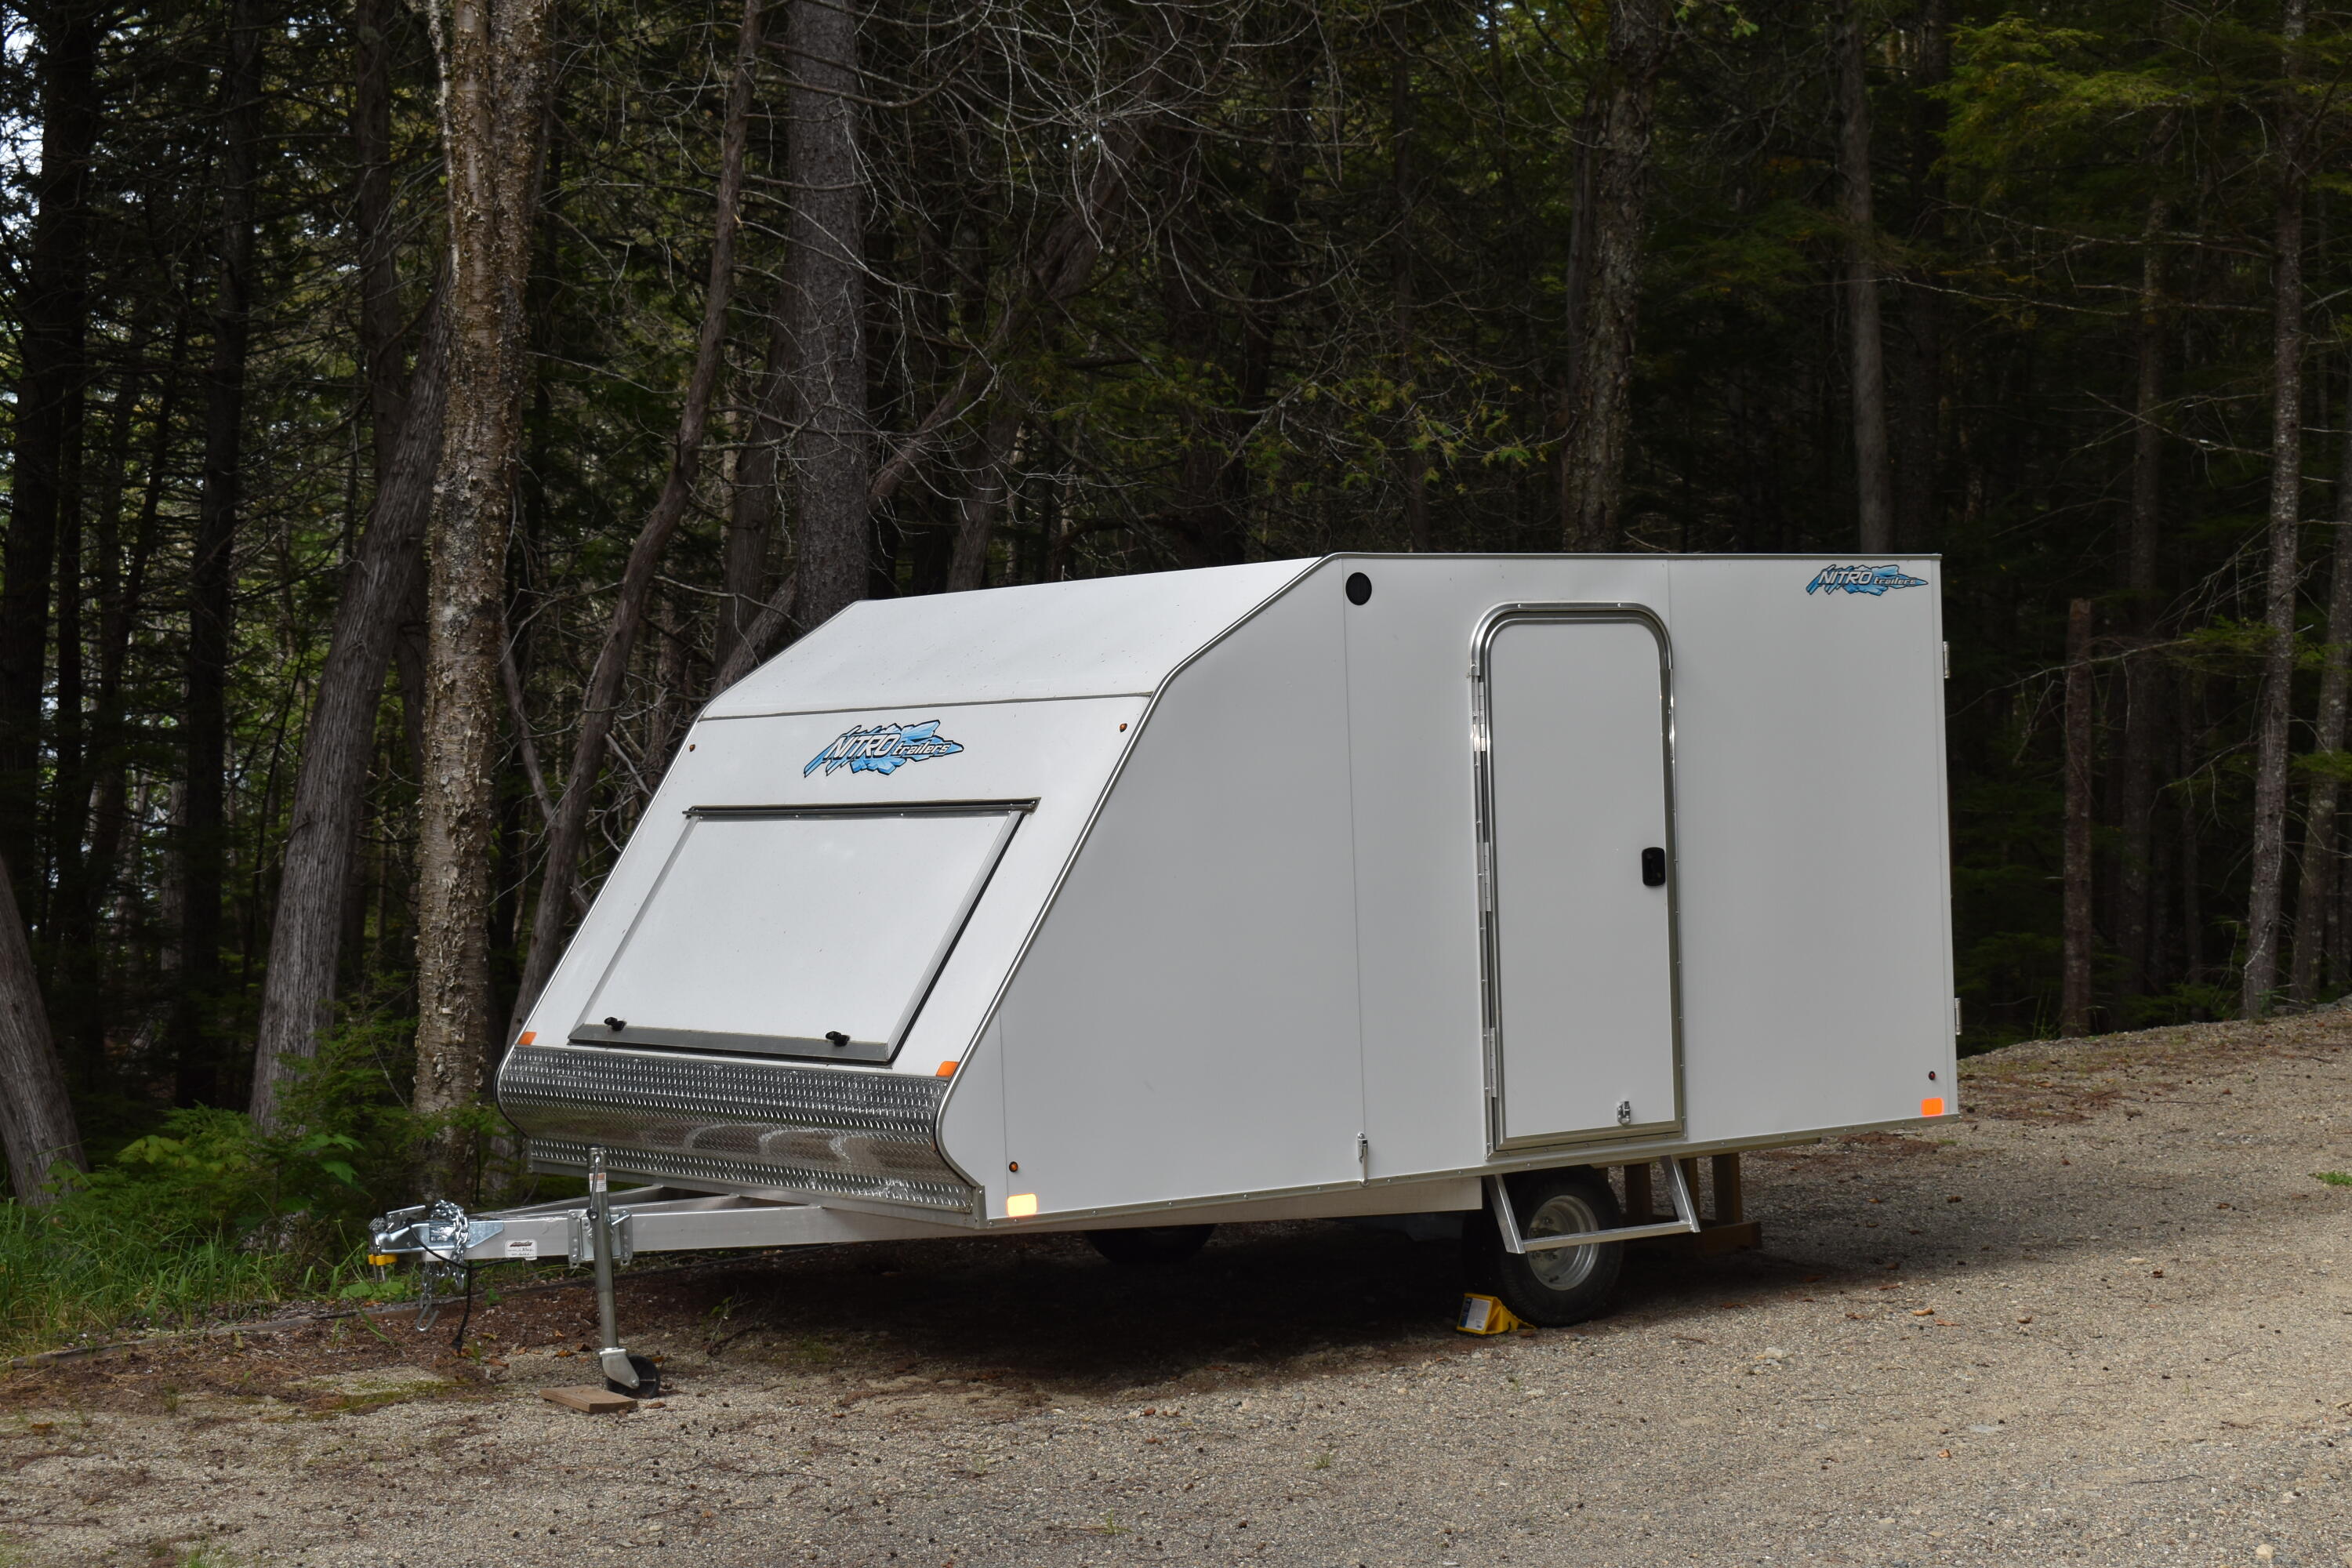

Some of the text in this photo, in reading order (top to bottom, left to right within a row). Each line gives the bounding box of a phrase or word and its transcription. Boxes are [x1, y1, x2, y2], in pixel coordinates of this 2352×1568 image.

[1817, 571, 1873, 585] NITRO
[823, 734, 950, 758] NITRO trailers
